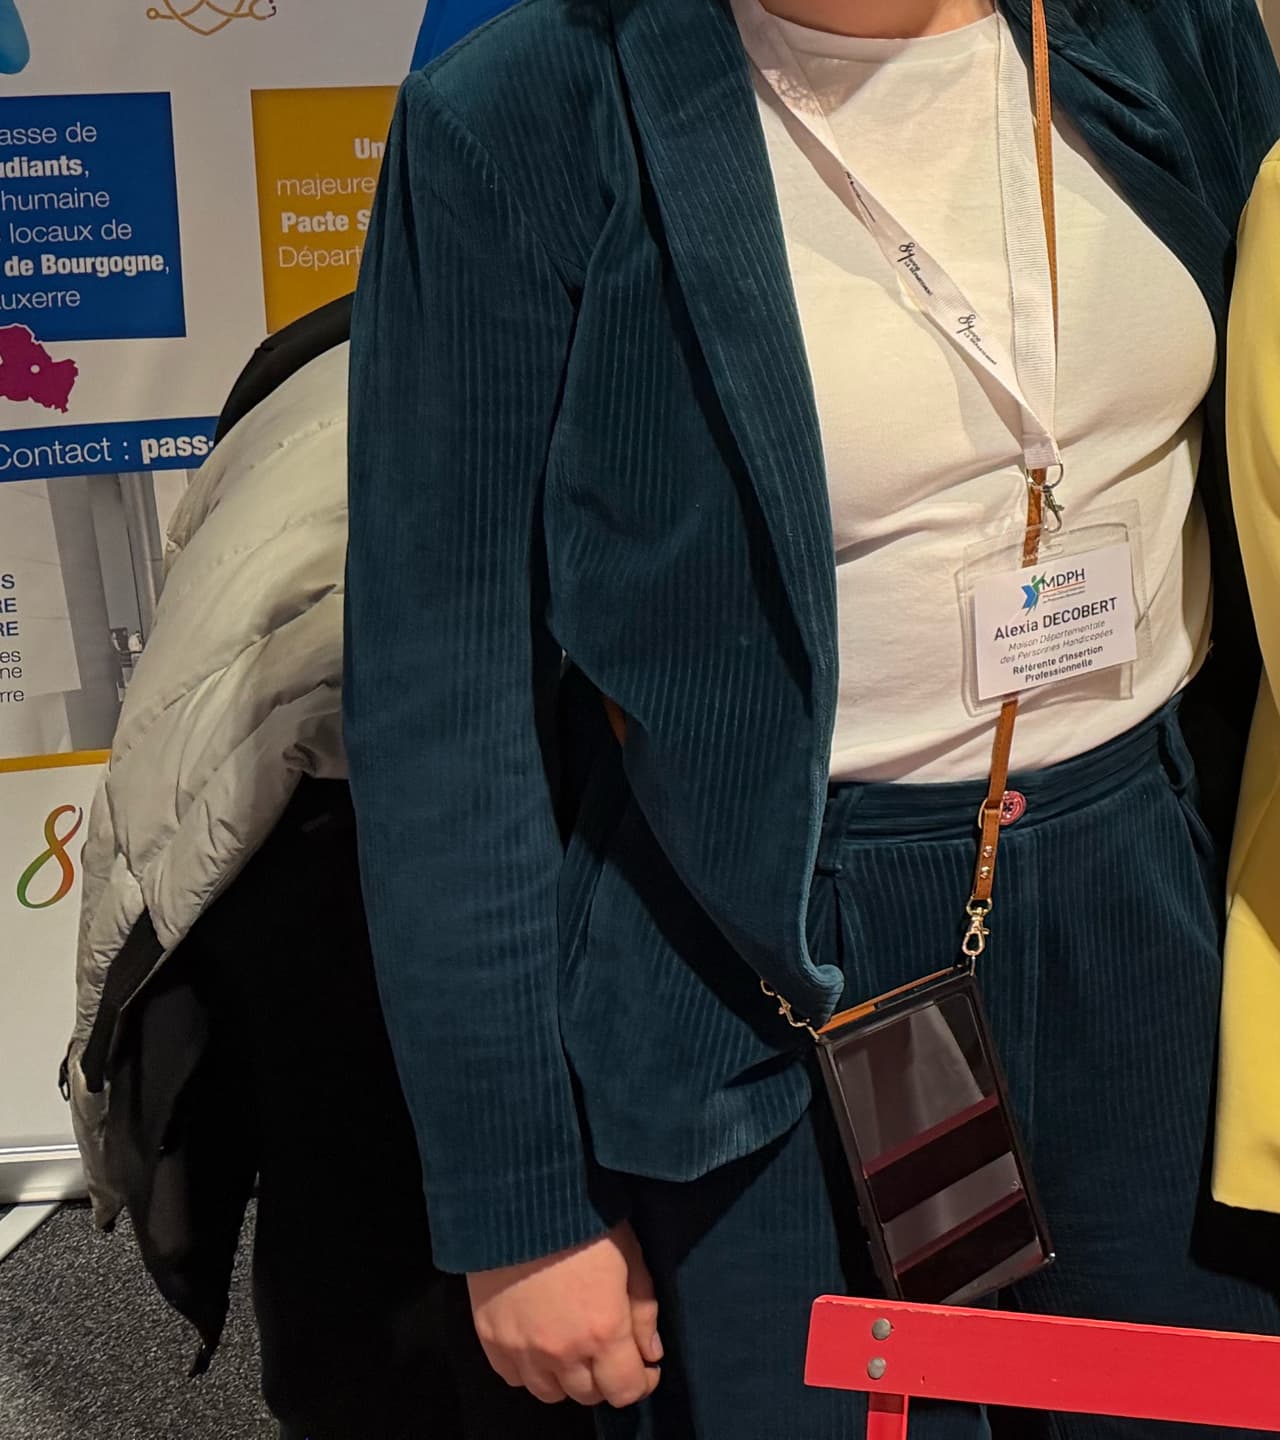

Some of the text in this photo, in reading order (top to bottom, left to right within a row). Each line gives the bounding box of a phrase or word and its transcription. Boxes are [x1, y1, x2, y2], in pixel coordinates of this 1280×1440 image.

[66, 121, 97, 143] de
[1, 187, 110, 211] humaine
[10, 219, 132, 244] locaux de
[281, 211, 349, 234] Pacte
[4, 253, 170, 278] de Bourgogne,
[0, 290, 81, 310] uxerre
[1041, 568, 1085, 591] MDPH
[994, 597, 1118, 640] Alexia DECOBERT
